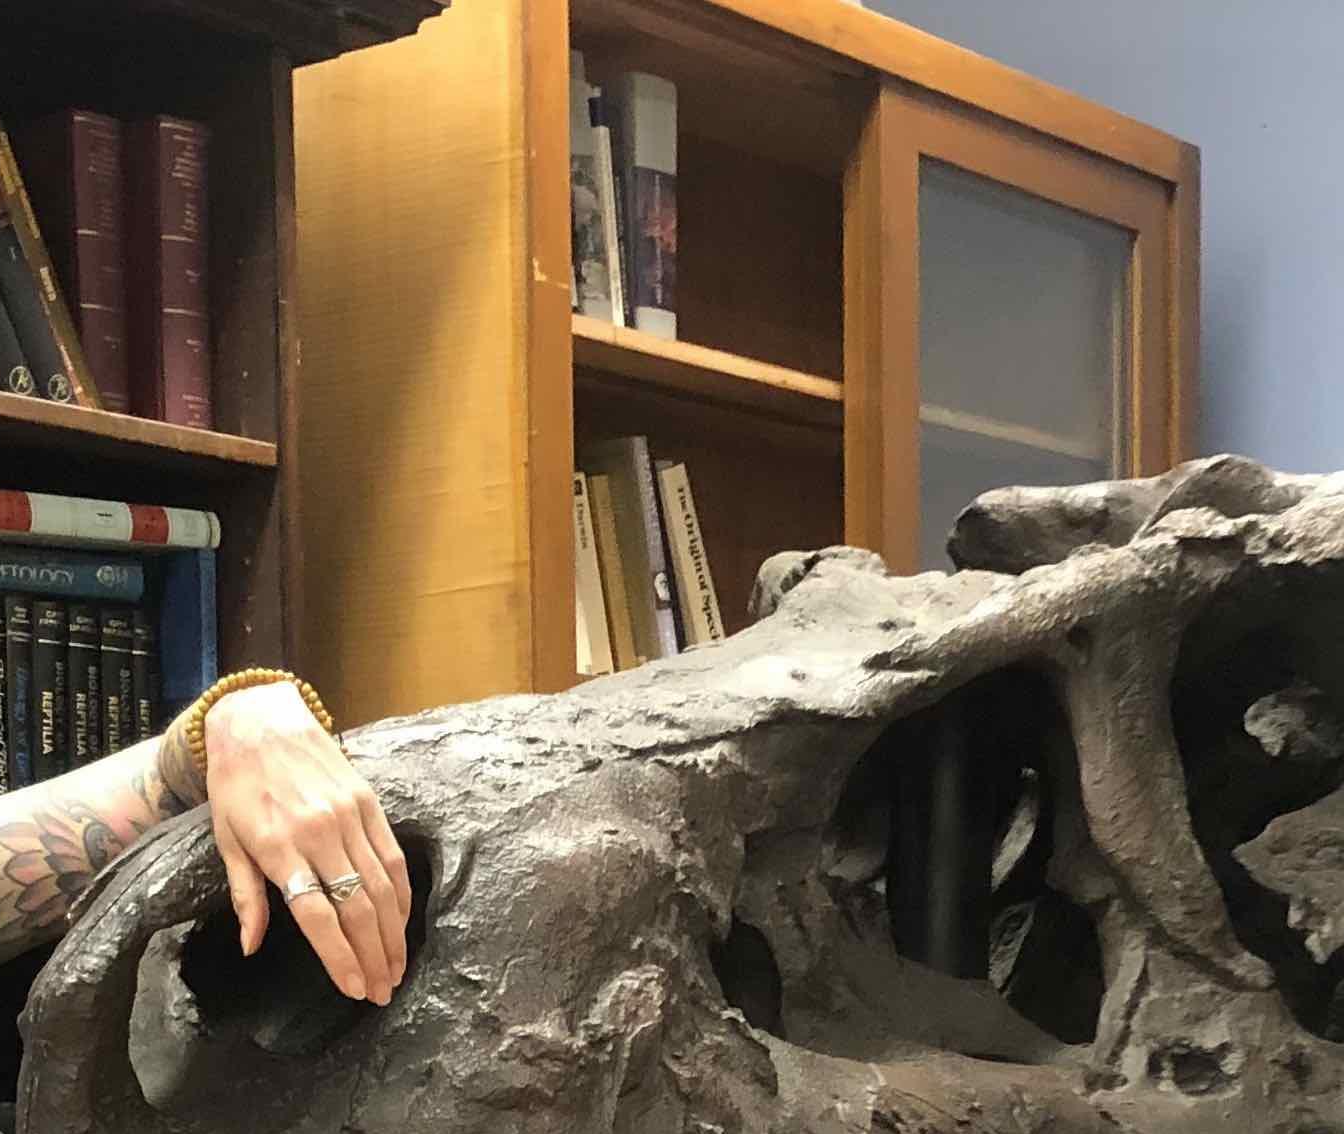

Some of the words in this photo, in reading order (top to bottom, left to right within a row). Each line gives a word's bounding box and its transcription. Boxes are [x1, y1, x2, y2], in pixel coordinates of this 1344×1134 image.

[684, 513, 703, 569] Origin
[41, 690, 55, 755] REPTILIA
[75, 692, 88, 756] REPTILIA
